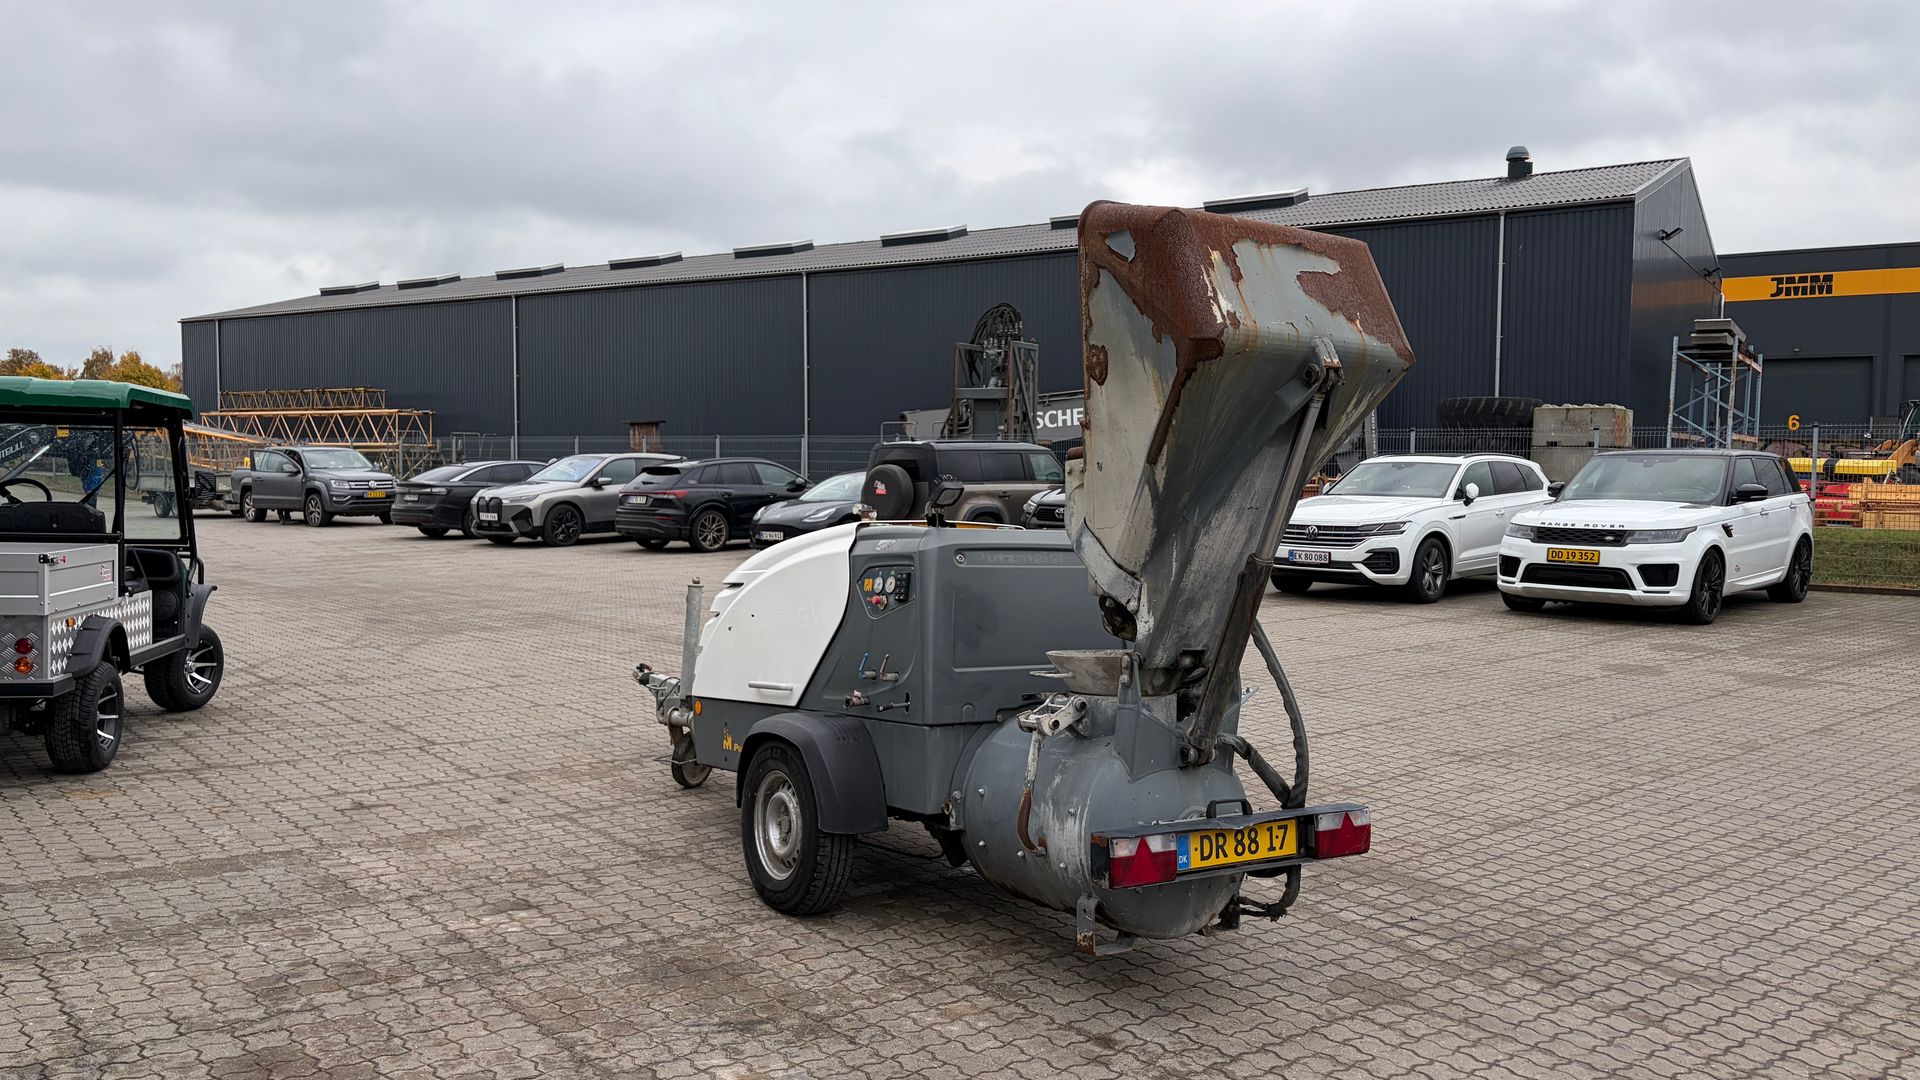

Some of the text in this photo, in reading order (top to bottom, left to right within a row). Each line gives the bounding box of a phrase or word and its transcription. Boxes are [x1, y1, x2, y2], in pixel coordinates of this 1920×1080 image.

[1769, 274, 1834, 298] JMM
[1788, 414, 1800, 431] 6
[1294, 552, 1328, 562] EK 80 088
[1551, 550, 1595, 561] DD 19 352
[1199, 824, 1289, 862] DR 88 17
[1178, 855, 1188, 864] DK
